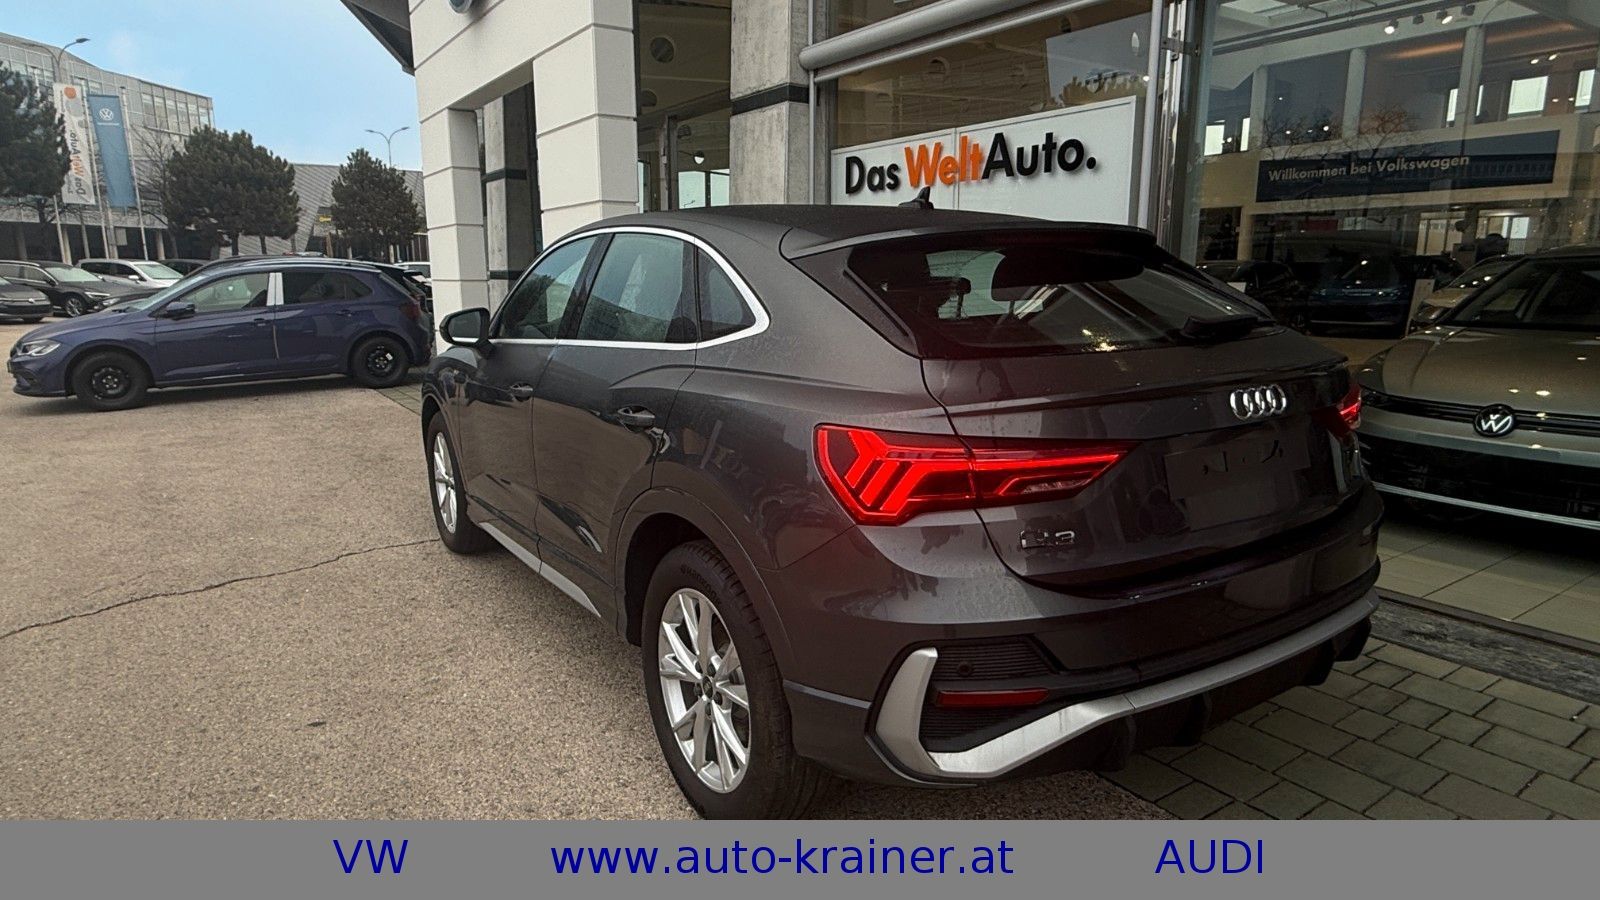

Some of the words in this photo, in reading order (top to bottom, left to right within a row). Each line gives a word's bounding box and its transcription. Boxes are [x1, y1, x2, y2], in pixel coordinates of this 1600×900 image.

[845, 156, 900, 195] Das
[904, 132, 1097, 188] WeltAuto.
[1268, 166, 1347, 182] Willkommen
[1350, 162, 1373, 175] bei
[1376, 156, 1470, 172] Volkswagen
